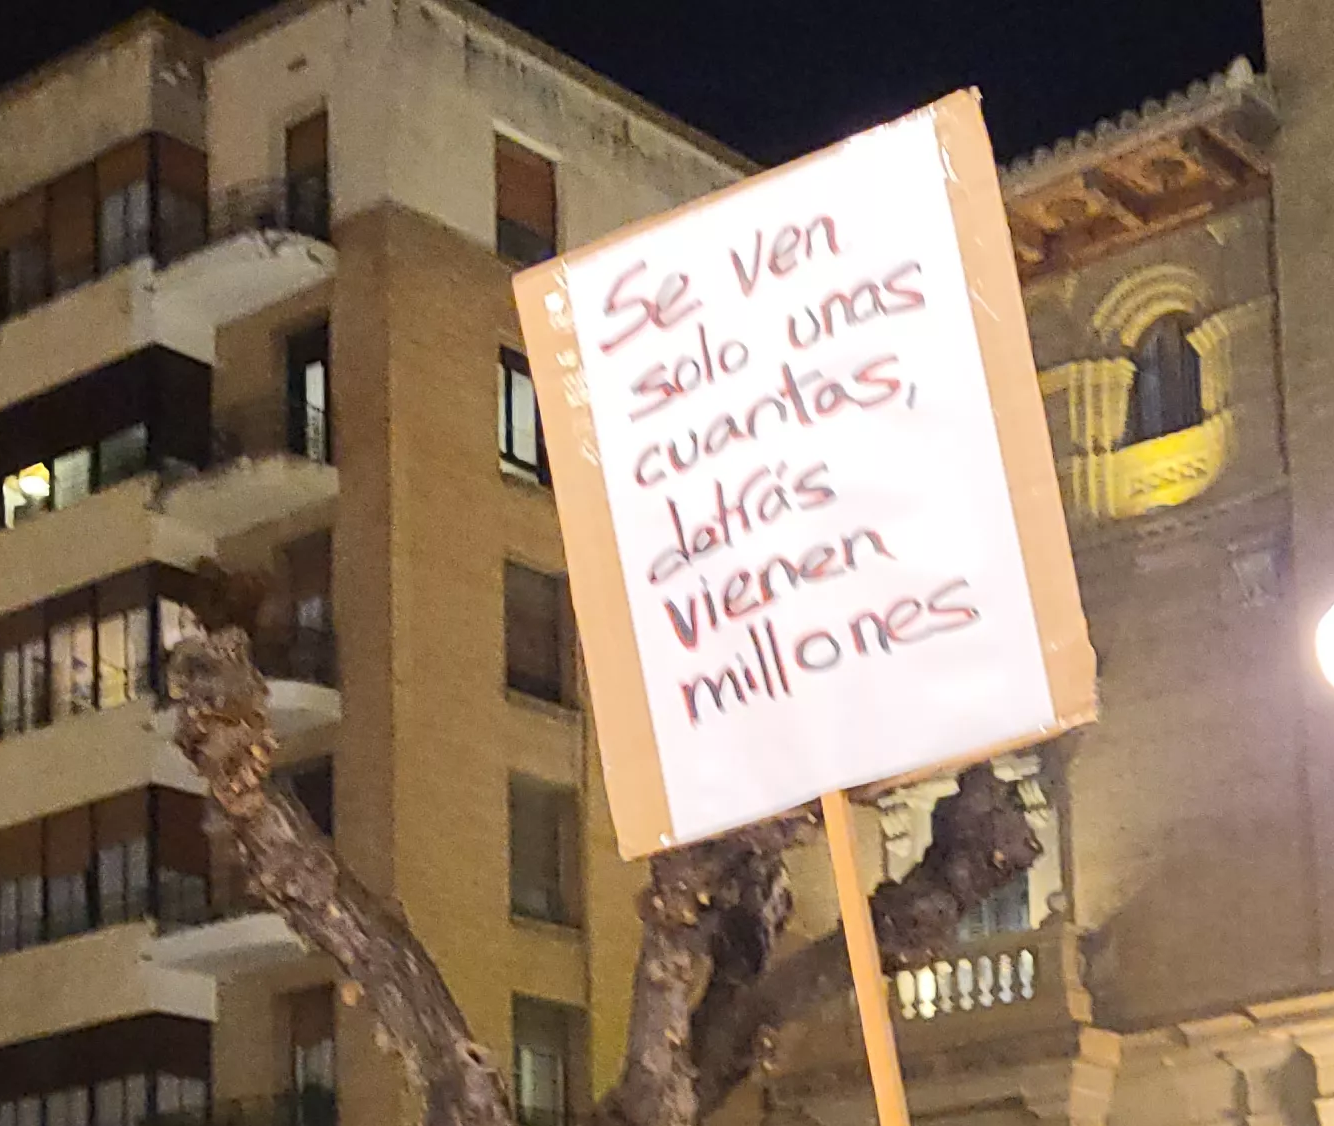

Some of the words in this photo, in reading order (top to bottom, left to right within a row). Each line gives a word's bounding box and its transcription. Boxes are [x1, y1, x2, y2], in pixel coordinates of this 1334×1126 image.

[600, 260, 703, 353] Se
[629, 322, 749, 423] solo
[788, 260, 925, 349] unas
[634, 356, 917, 487] cuantas,
[648, 460, 837, 584] detrás
[663, 526, 897, 651] vienen
[679, 577, 980, 729] millones
